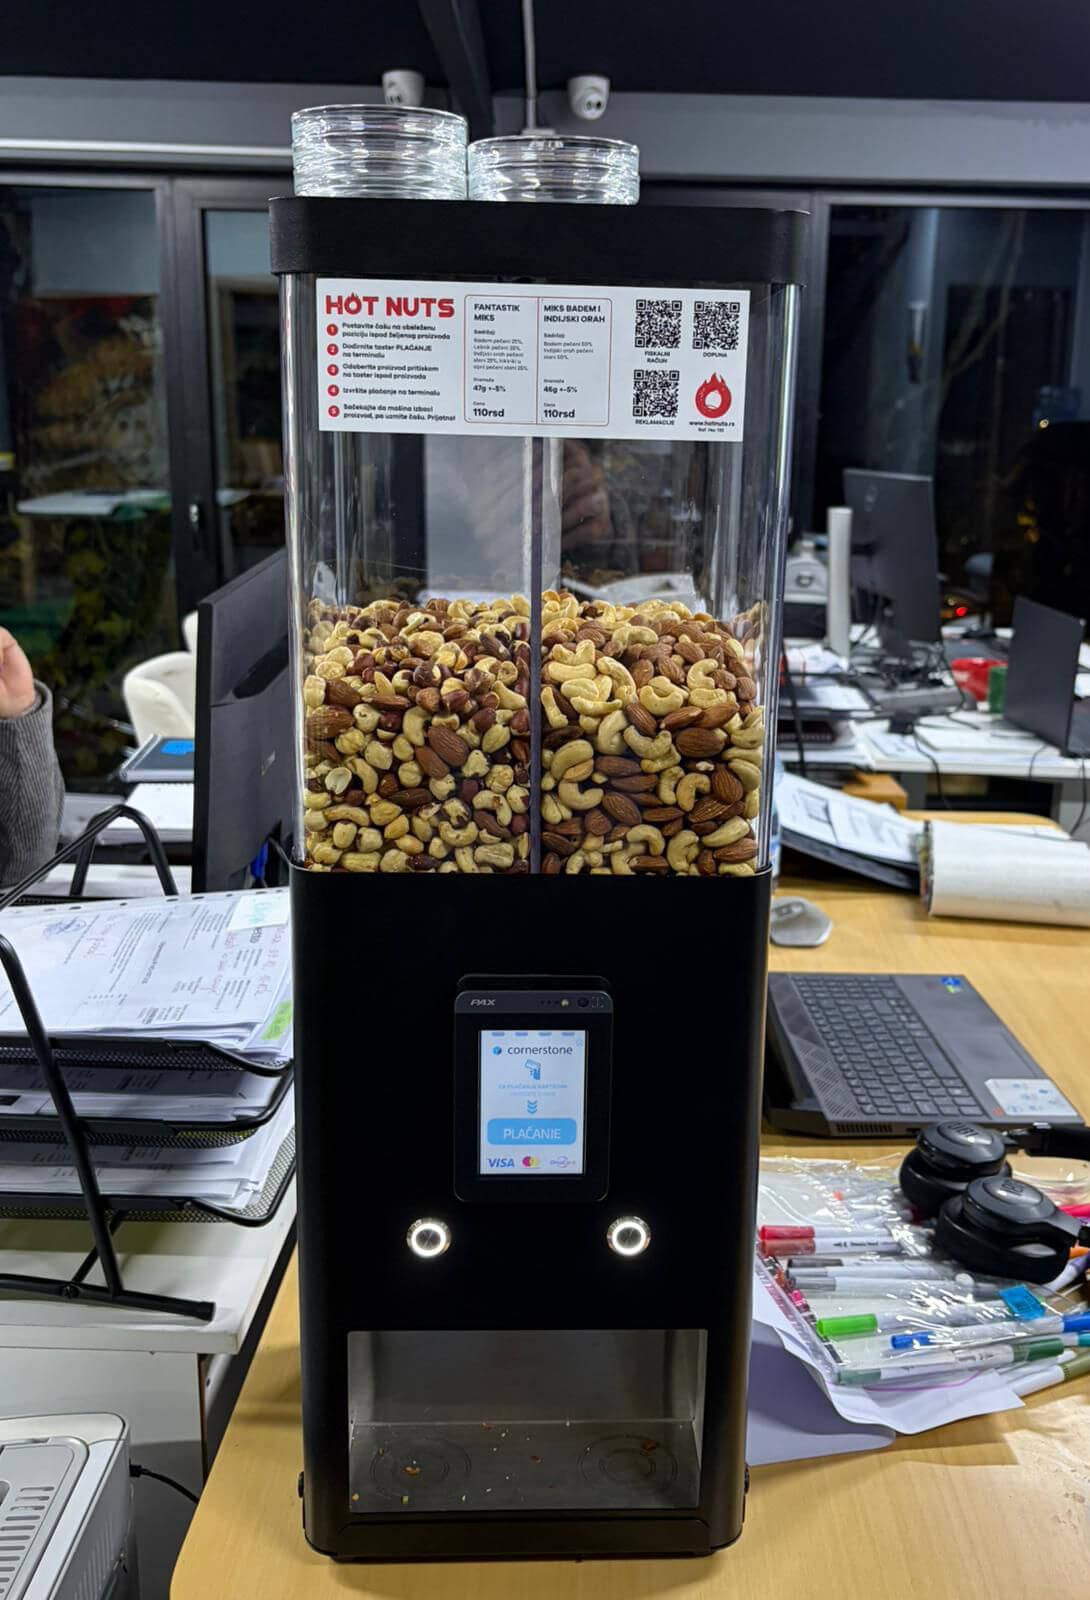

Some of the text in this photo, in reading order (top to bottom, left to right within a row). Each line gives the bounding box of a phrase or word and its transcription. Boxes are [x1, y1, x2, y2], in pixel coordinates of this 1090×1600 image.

[326, 292, 455, 318] HOT NUTS
[473, 303, 521, 312] FANTASTIK
[544, 304, 565, 312] MIKS
[580, 315, 606, 323] ORAH
[342, 322, 374, 330] Postavite
[374, 322, 391, 331] čašu
[402, 323, 436, 332] obeleženu
[342, 331, 451, 341] poziciju ispod željenog proizvoda
[342, 342, 374, 350] Dodirnite
[374, 343, 395, 351] taster
[342, 351, 386, 359] na terminalu
[377, 363, 407, 372] proizvod
[407, 364, 440, 373] pritiskom
[353, 371, 374, 379] taster
[374, 372, 393, 380] ispod
[393, 373, 427, 381] proizvoda
[342, 386, 368, 395] Izvršite
[398, 388, 408, 396] na
[408, 388, 441, 397] terminalu
[473, 384, 487, 393] 47g
[473, 408, 505, 418] 110rsd
[544, 409, 577, 419] 110rsd
[470, 999, 496, 1007] PAX
[507, 1045, 573, 1055] cornerstone
[487, 1158, 515, 1168] VISA
